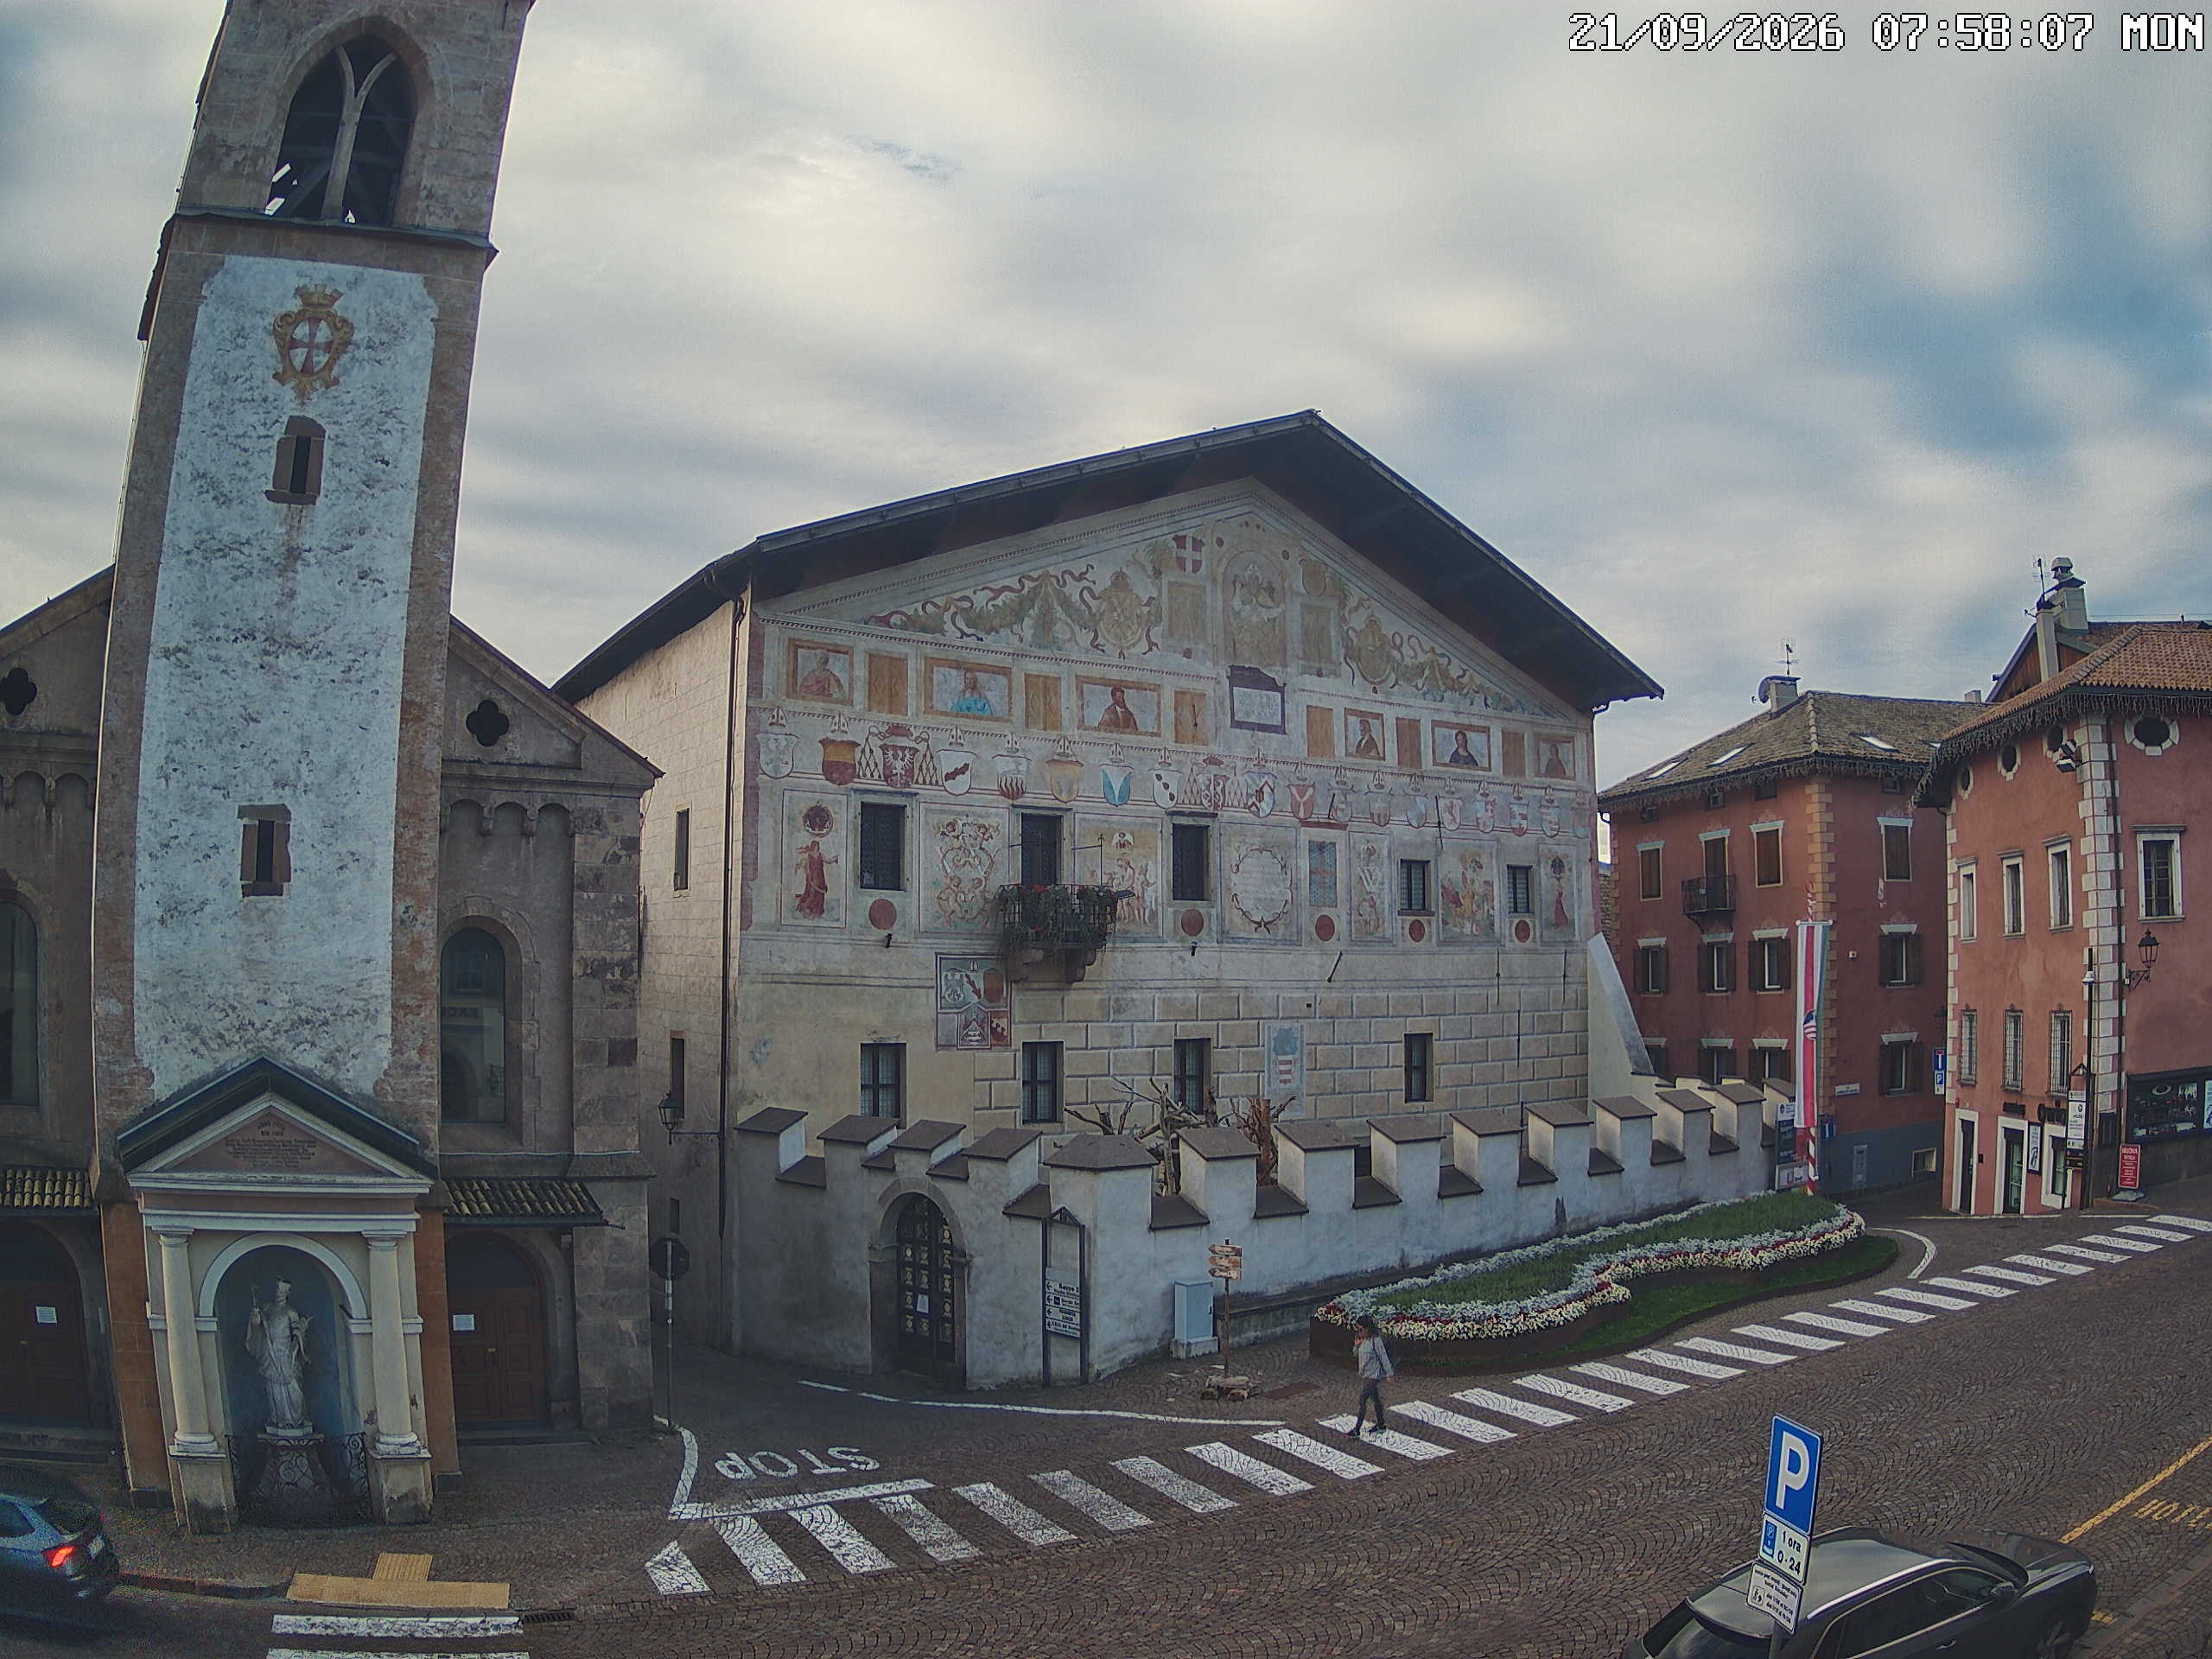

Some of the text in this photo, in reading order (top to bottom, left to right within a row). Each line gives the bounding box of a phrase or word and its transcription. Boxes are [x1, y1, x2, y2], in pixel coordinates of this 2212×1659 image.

[715, 1446, 880, 1480] STOP
[1776, 1431, 1809, 1510] P
[1788, 1536, 1802, 1553] ora
